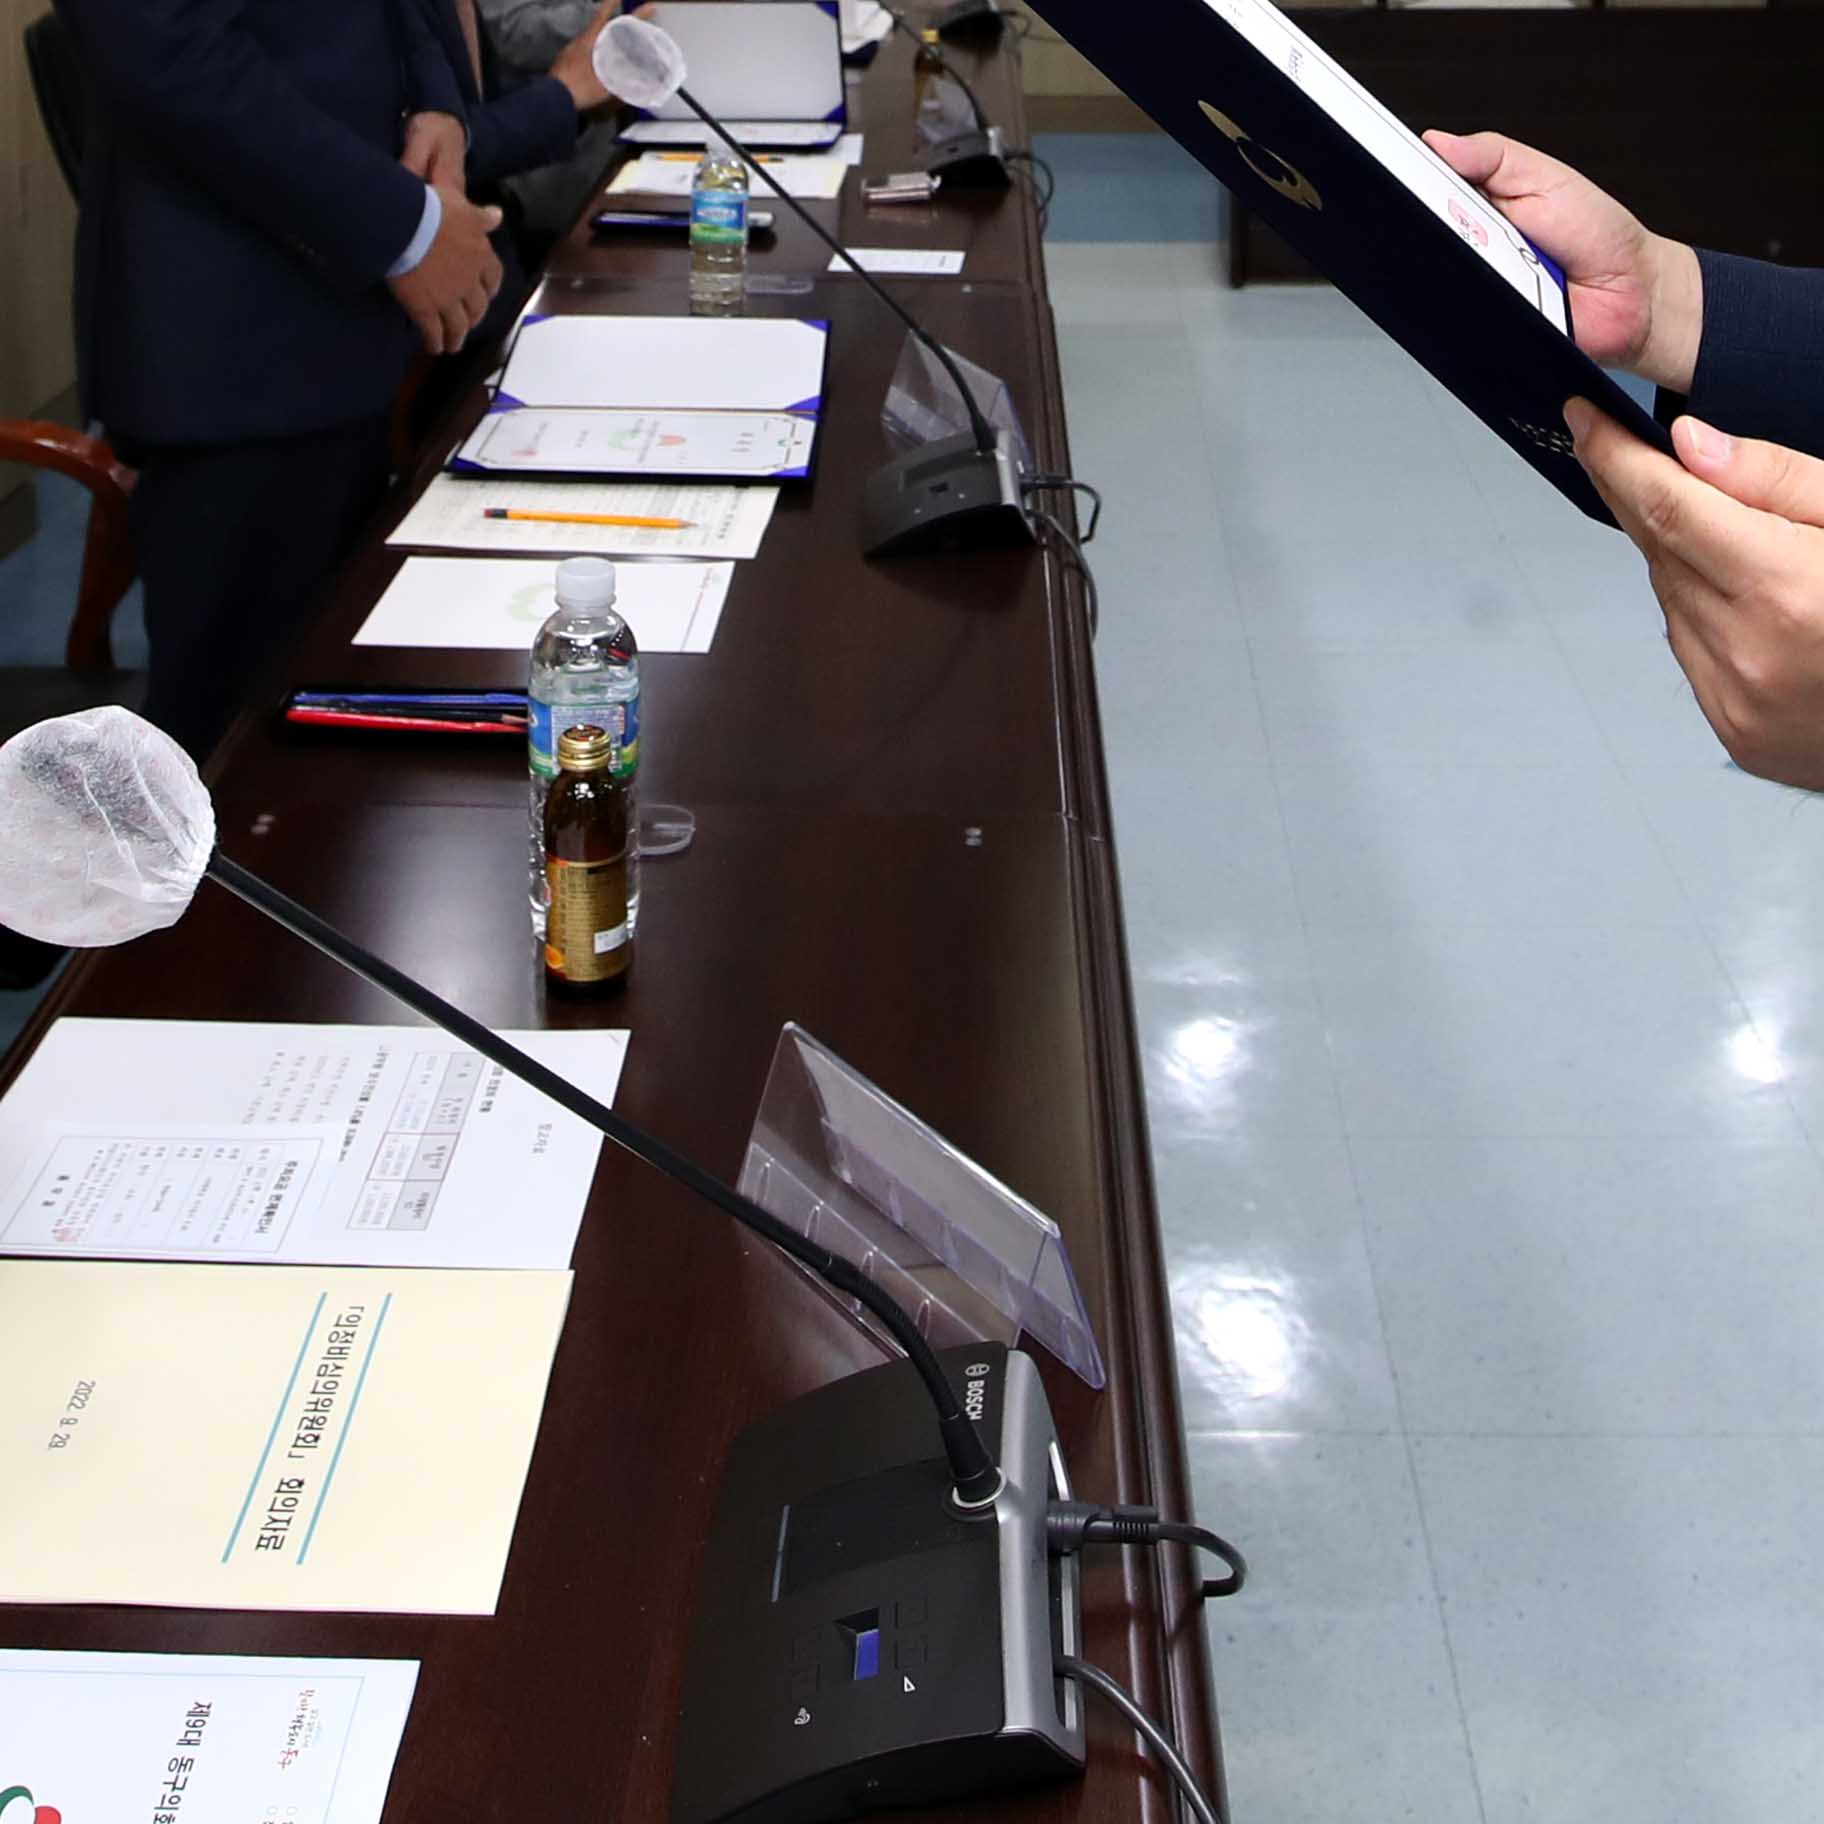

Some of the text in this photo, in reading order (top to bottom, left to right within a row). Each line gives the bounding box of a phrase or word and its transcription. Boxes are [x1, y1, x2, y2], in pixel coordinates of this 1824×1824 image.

[964, 1379, 985, 1421] BOSCH
[254, 1477, 306, 1552] 회의자료
[175, 1700, 213, 1747] 제9대
